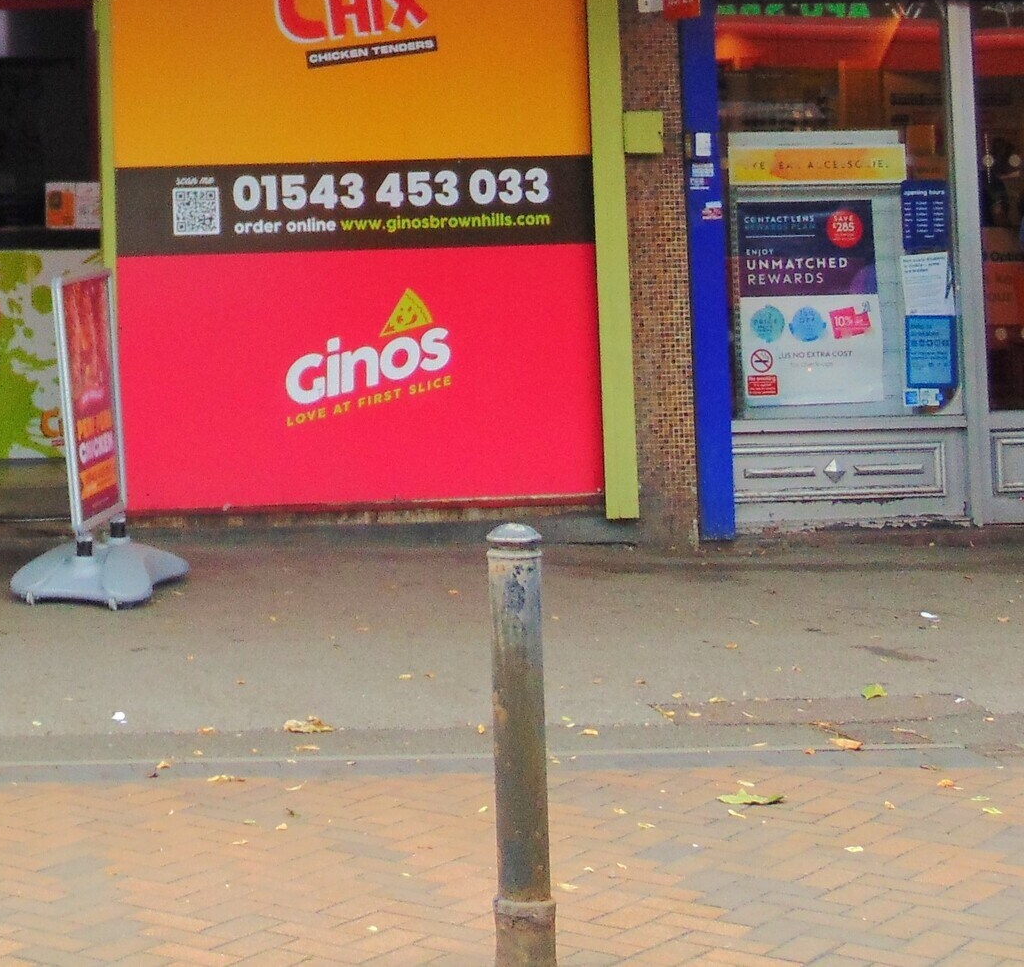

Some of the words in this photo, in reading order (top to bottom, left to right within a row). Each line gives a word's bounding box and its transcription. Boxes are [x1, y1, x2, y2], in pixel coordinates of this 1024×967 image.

[309, 47, 369, 64] CHICKEN
[371, 39, 435, 56] TENDERS
[232, 172, 365, 211] 01543
[375, 169, 459, 207] 453
[468, 167, 550, 205] 033
[234, 219, 282, 234] order
[286, 217, 336, 233] online
[340, 213, 551, 233] www.ginosbrownhills.com
[743, 215, 788, 224] CONTACT
[790, 215, 815, 223] LENS
[833, 214, 854, 222] SAVE
[832, 221, 855, 233] £285
[745, 248, 774, 257] ENJOY
[746, 257, 848, 271] UNMATCHED
[747, 272, 824, 286] REWARDS
[285, 327, 452, 405] Ginos
[286, 407, 326, 428] LOVE
[333, 400, 352, 415] AT
[357, 388, 402, 409] FIRST
[408, 375, 453, 396] SLICE
